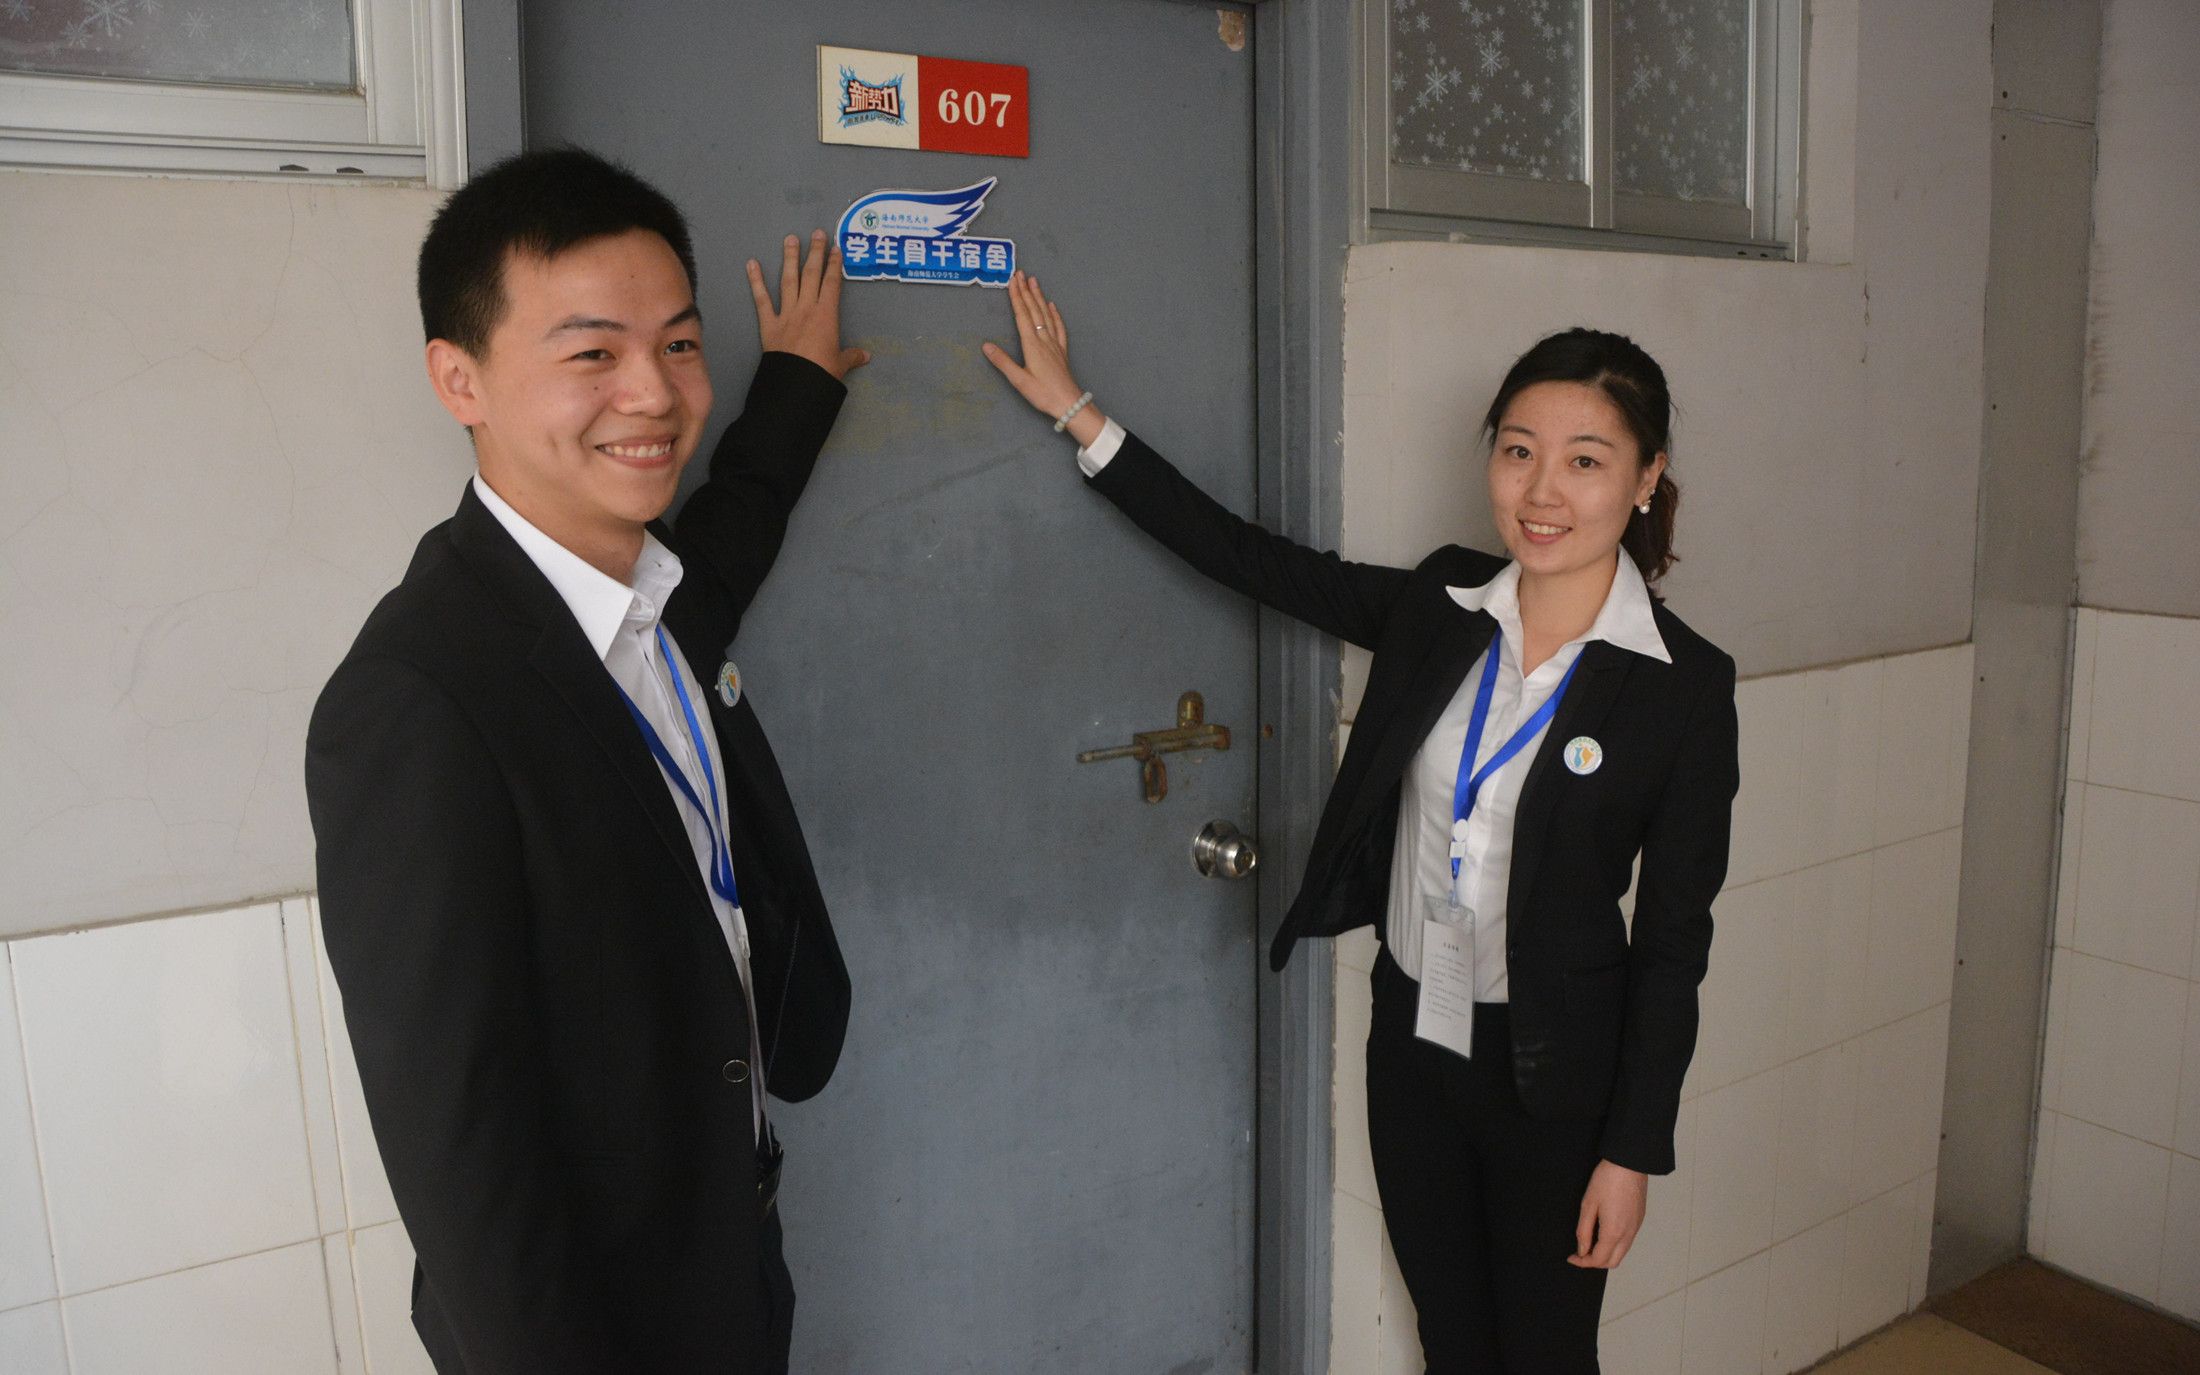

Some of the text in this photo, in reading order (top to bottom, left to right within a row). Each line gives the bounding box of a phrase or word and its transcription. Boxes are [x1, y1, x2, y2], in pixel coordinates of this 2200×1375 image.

[845, 80, 899, 116] 新势力
[938, 89, 1011, 128] 607
[846, 235, 1007, 270] 学生骨干宿舍
